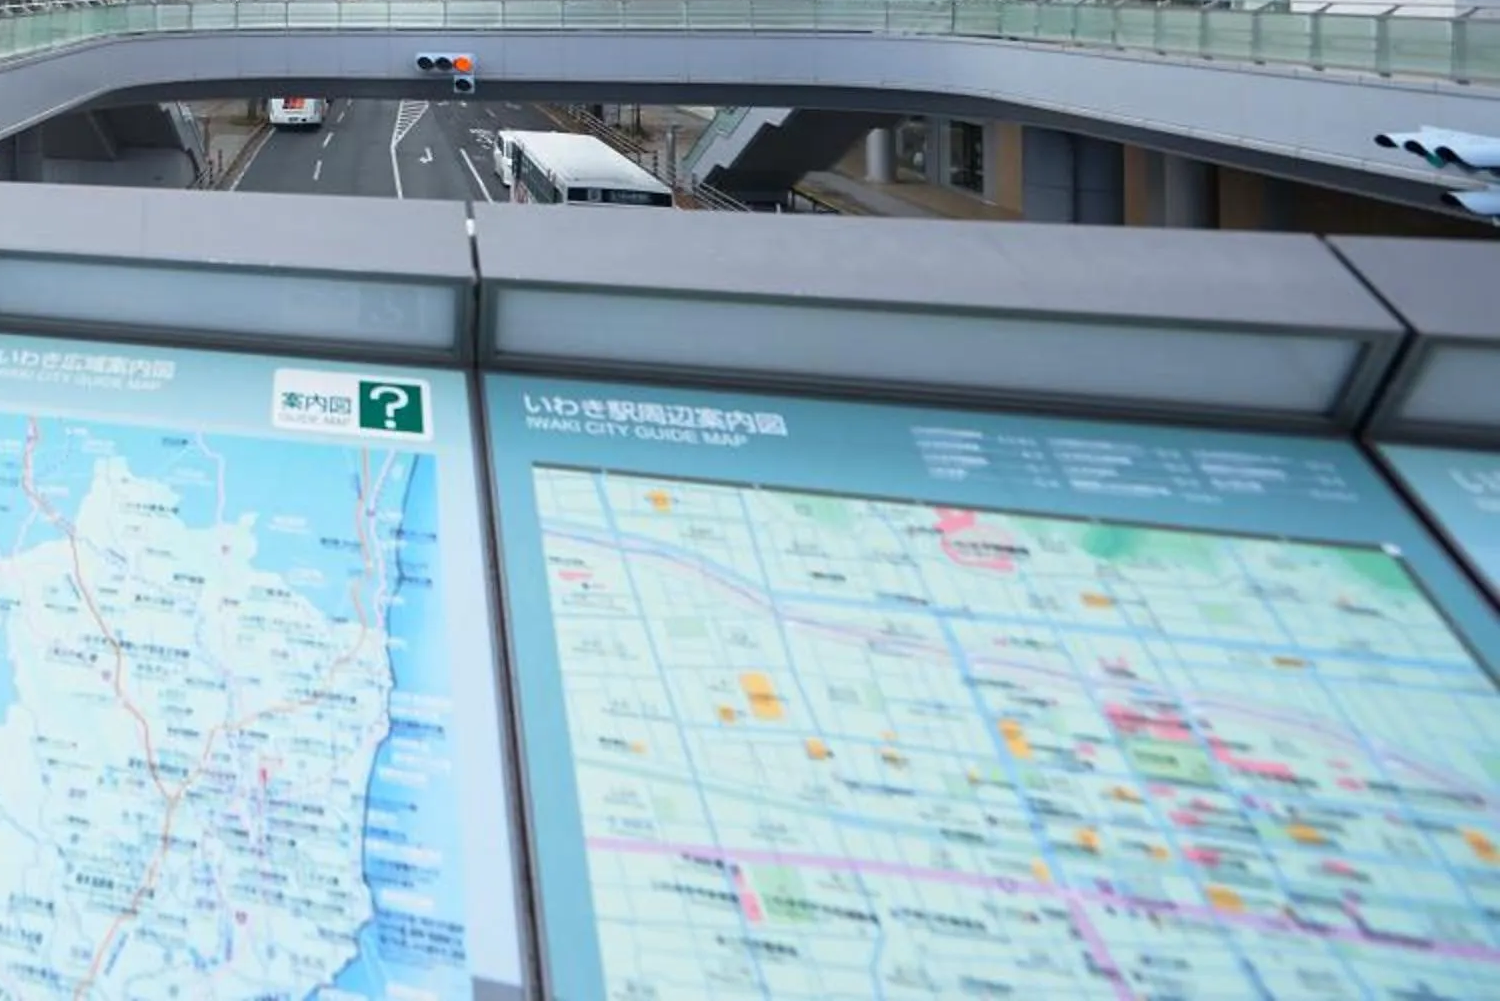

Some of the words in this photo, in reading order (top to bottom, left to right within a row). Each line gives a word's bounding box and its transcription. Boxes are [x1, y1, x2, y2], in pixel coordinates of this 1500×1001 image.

[282, 392, 352, 414] 案内図
[523, 395, 787, 436] いわき駅周辺案内図
[526, 415, 581, 433] IWAKI
[585, 419, 629, 437] CITY
[634, 426, 698, 444] GUIDE
[702, 430, 748, 447] MAP
